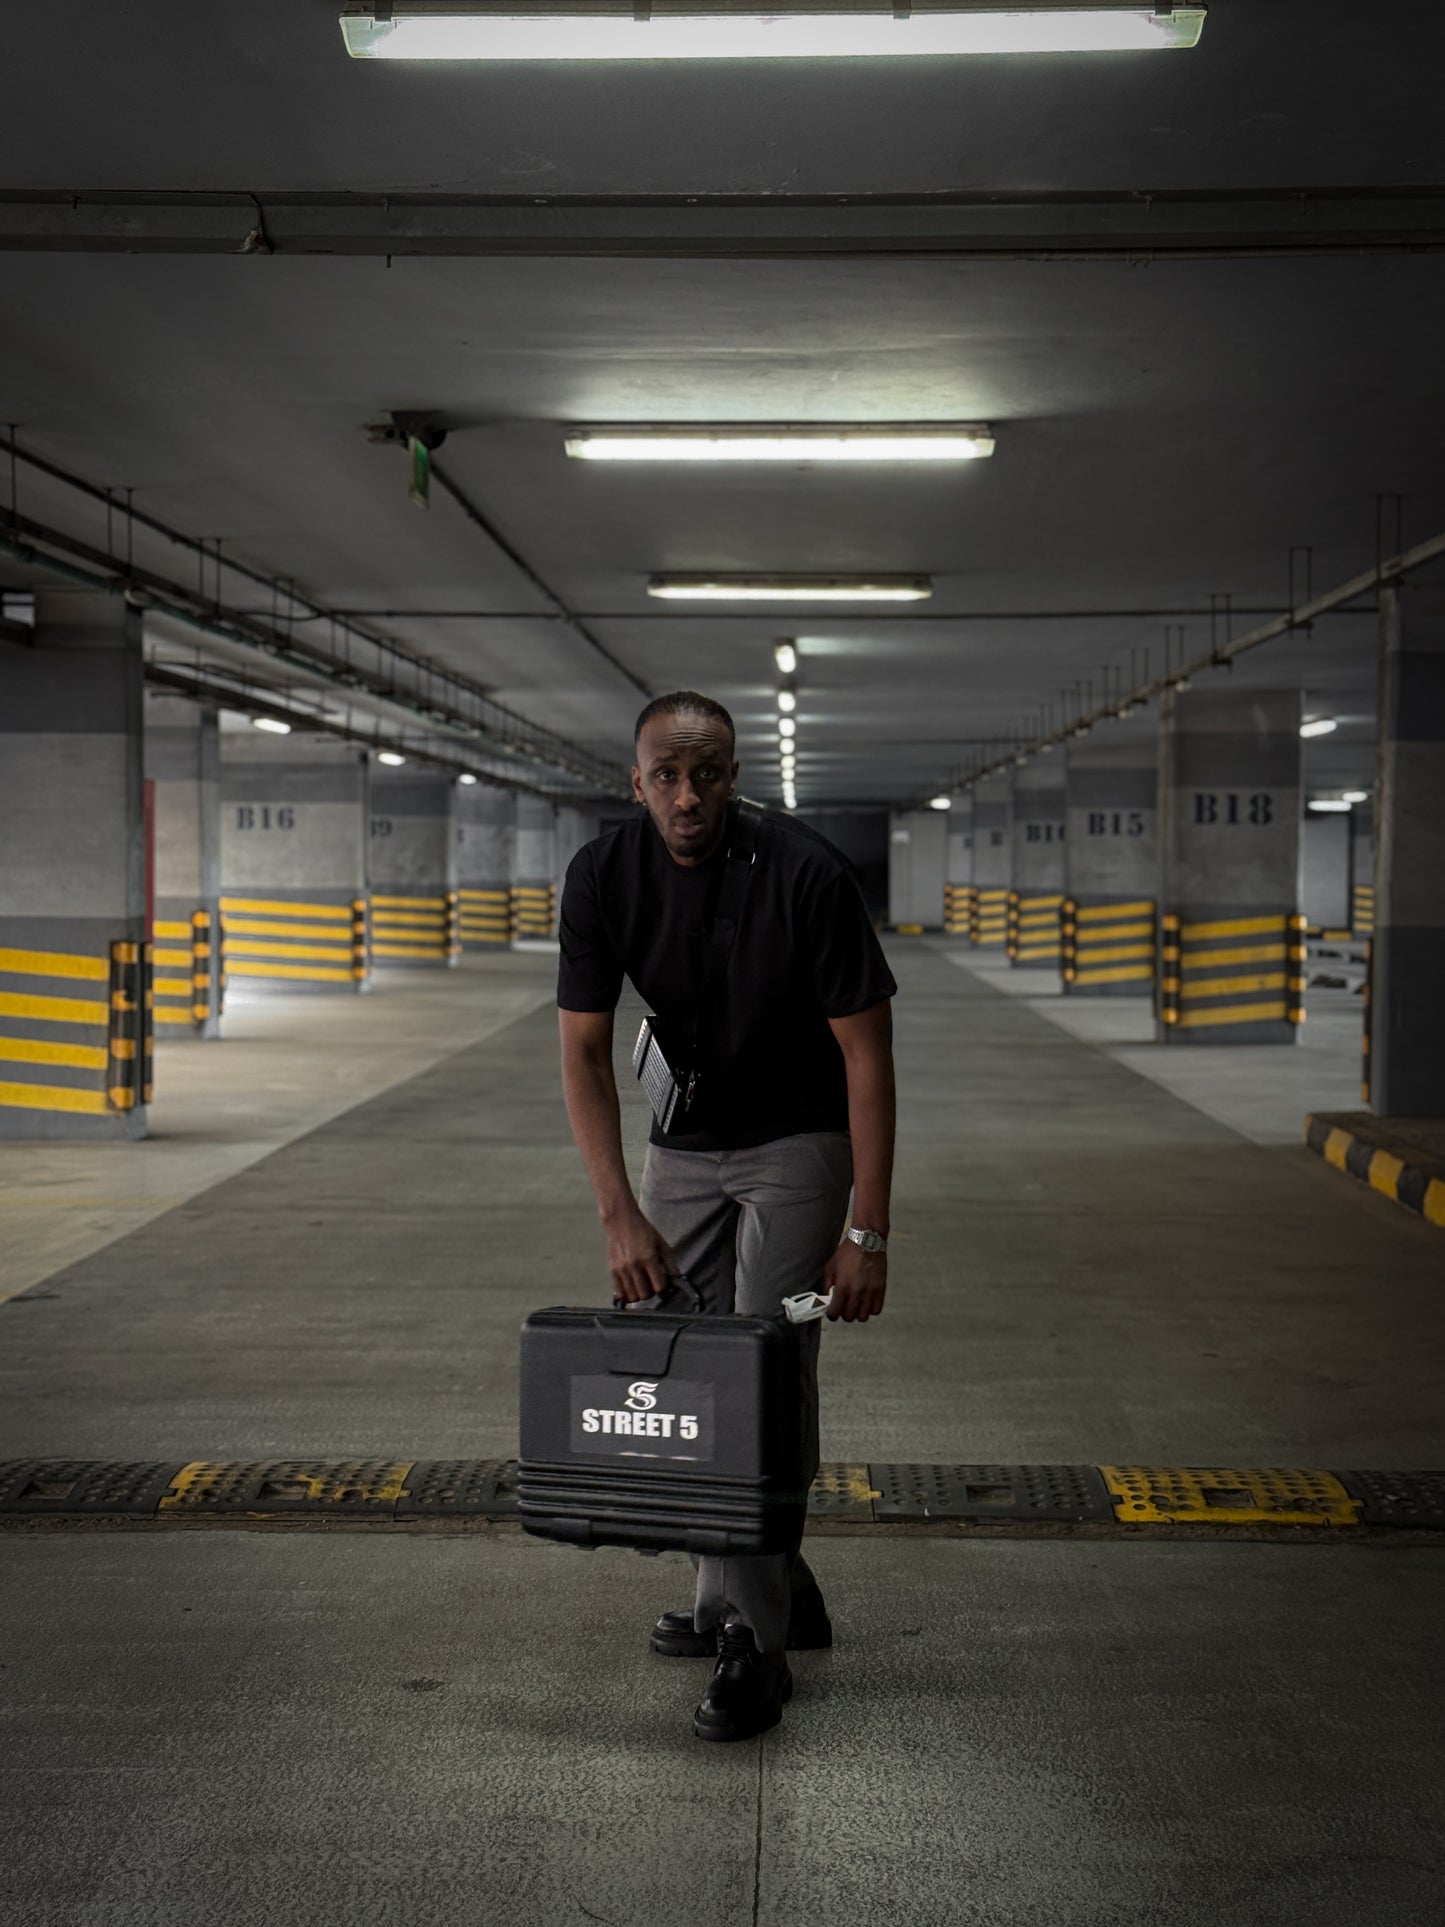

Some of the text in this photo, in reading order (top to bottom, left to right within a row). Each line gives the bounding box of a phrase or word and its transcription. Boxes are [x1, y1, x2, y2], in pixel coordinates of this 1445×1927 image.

[237, 807, 294, 831] B16
[1195, 793, 1272, 825] B18
[1088, 813, 1144, 836] B15
[582, 1408, 699, 1440] STREET 5
